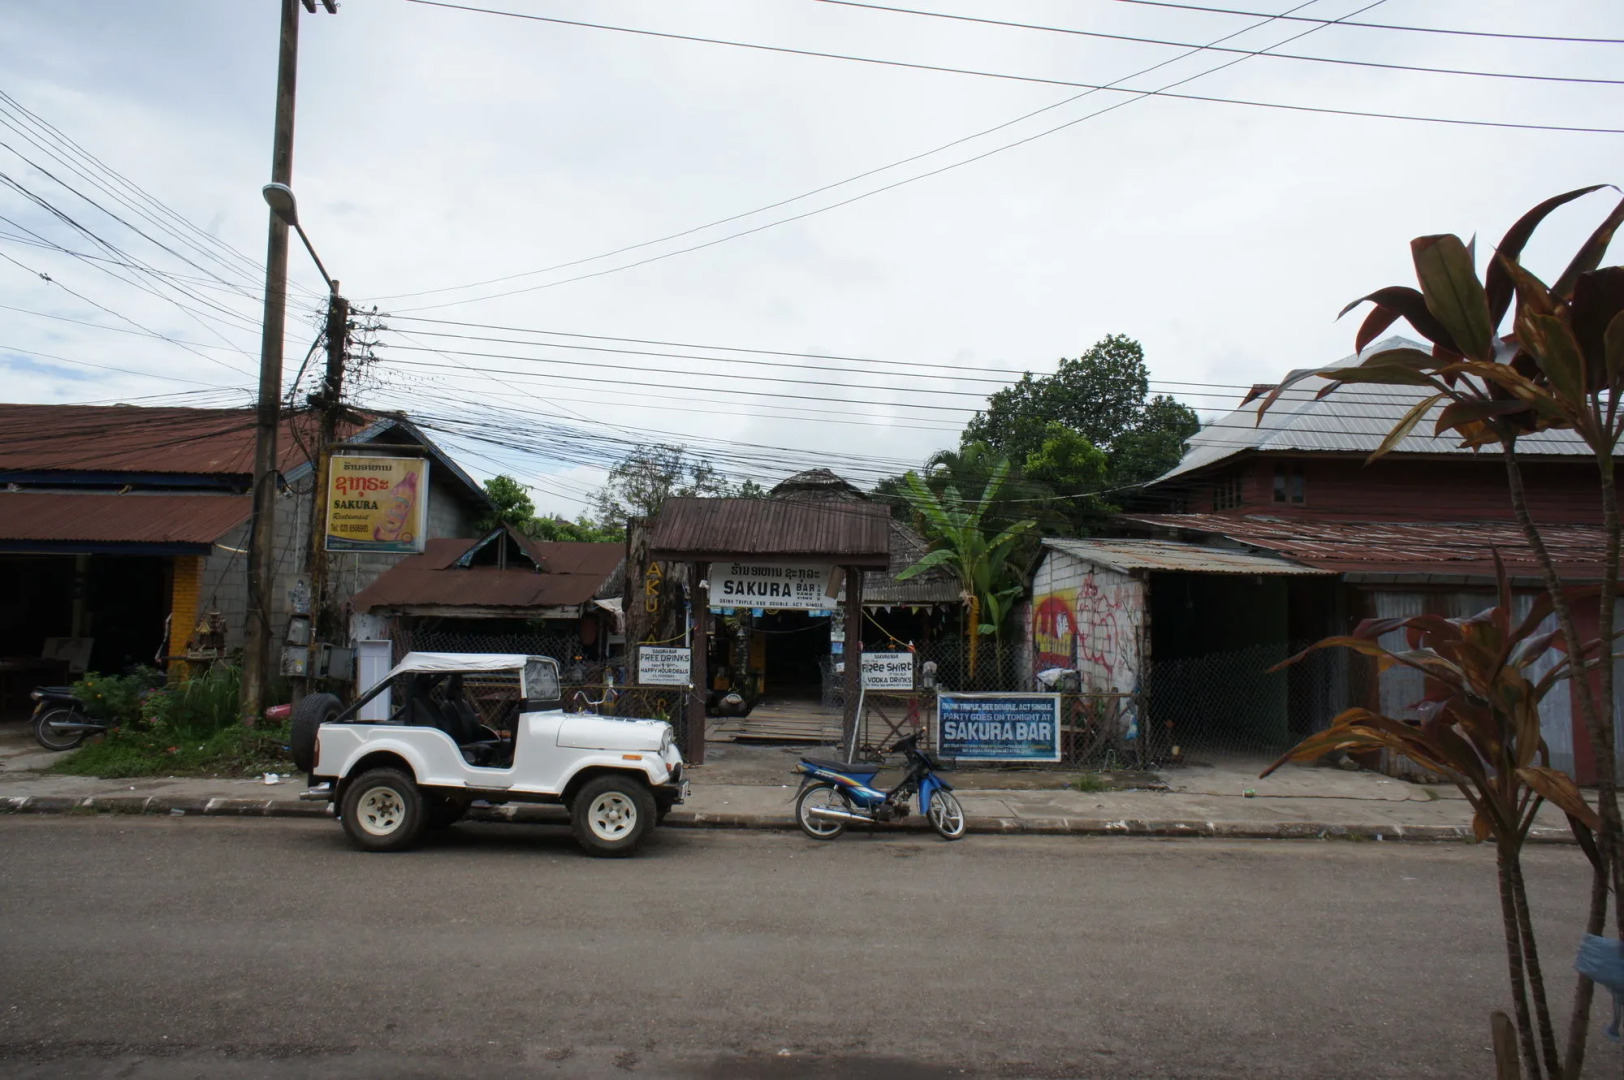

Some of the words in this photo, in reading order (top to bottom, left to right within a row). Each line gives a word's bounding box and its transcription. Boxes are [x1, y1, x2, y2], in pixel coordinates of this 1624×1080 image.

[334, 500, 378, 510] SAKURA
[724, 580, 792, 597] SAKURA
[796, 583, 815, 592] BAR
[645, 561, 664, 644] AKUA
[944, 721, 1014, 740] SAKURA
[1016, 722, 1051, 740] BAR
